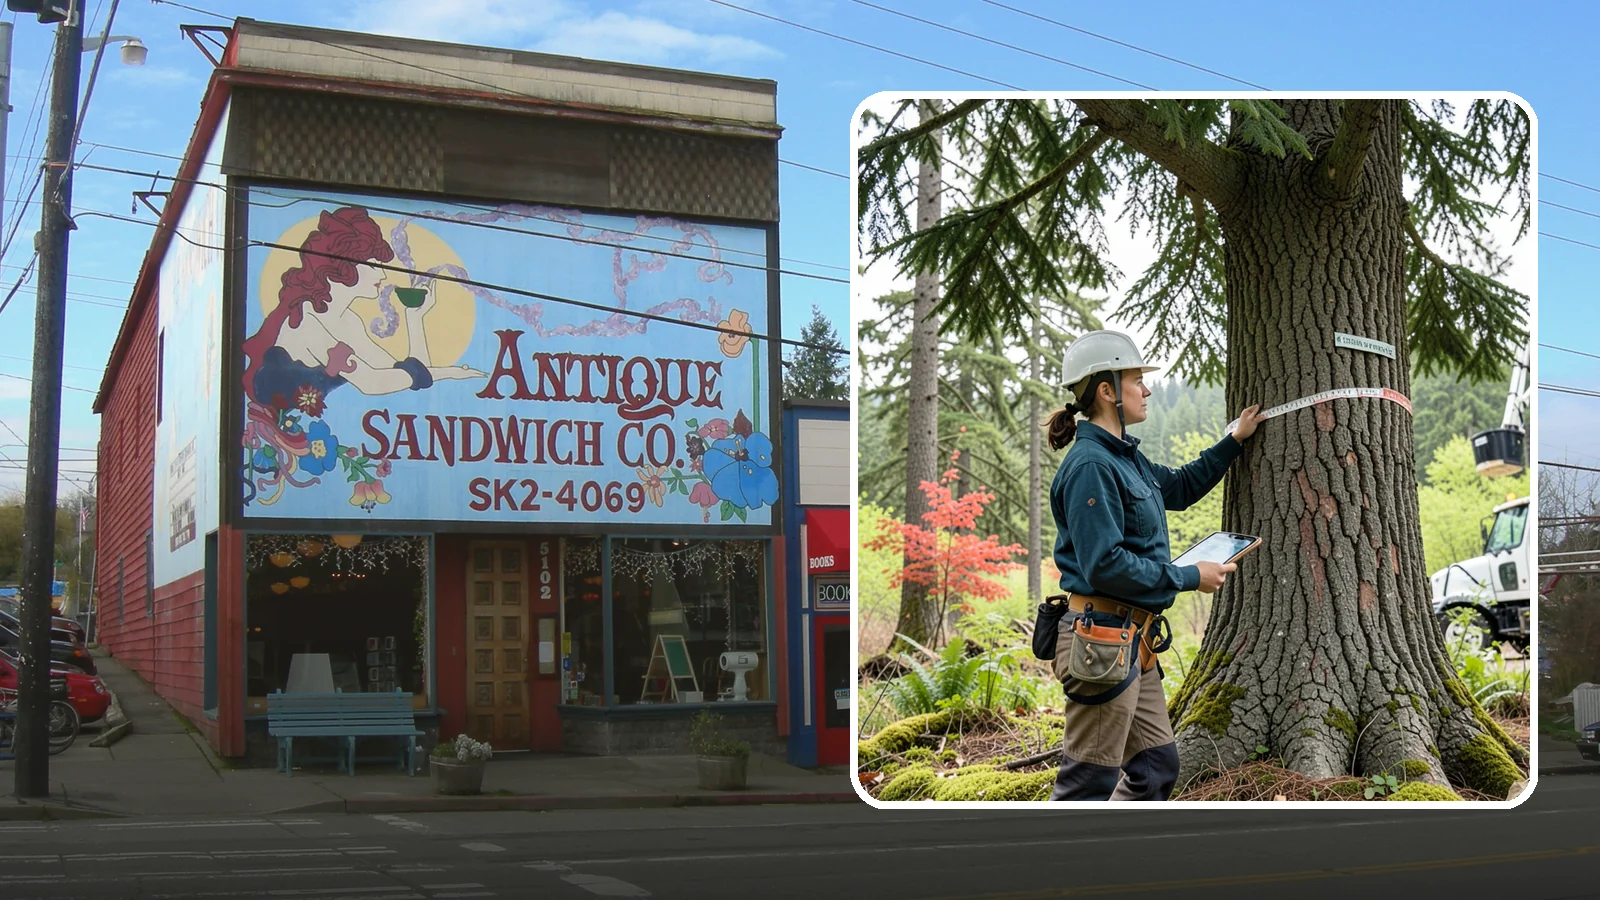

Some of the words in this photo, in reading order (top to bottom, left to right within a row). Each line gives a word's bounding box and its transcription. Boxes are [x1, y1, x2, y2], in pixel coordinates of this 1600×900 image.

[476, 329, 723, 420] ANTIQUE
[361, 408, 604, 467] SANDWICH
[617, 422, 684, 468] CO.
[468, 477, 645, 513] SK2-4069
[540, 542, 551, 599] 5102
[809, 555, 835, 569] BOOKS
